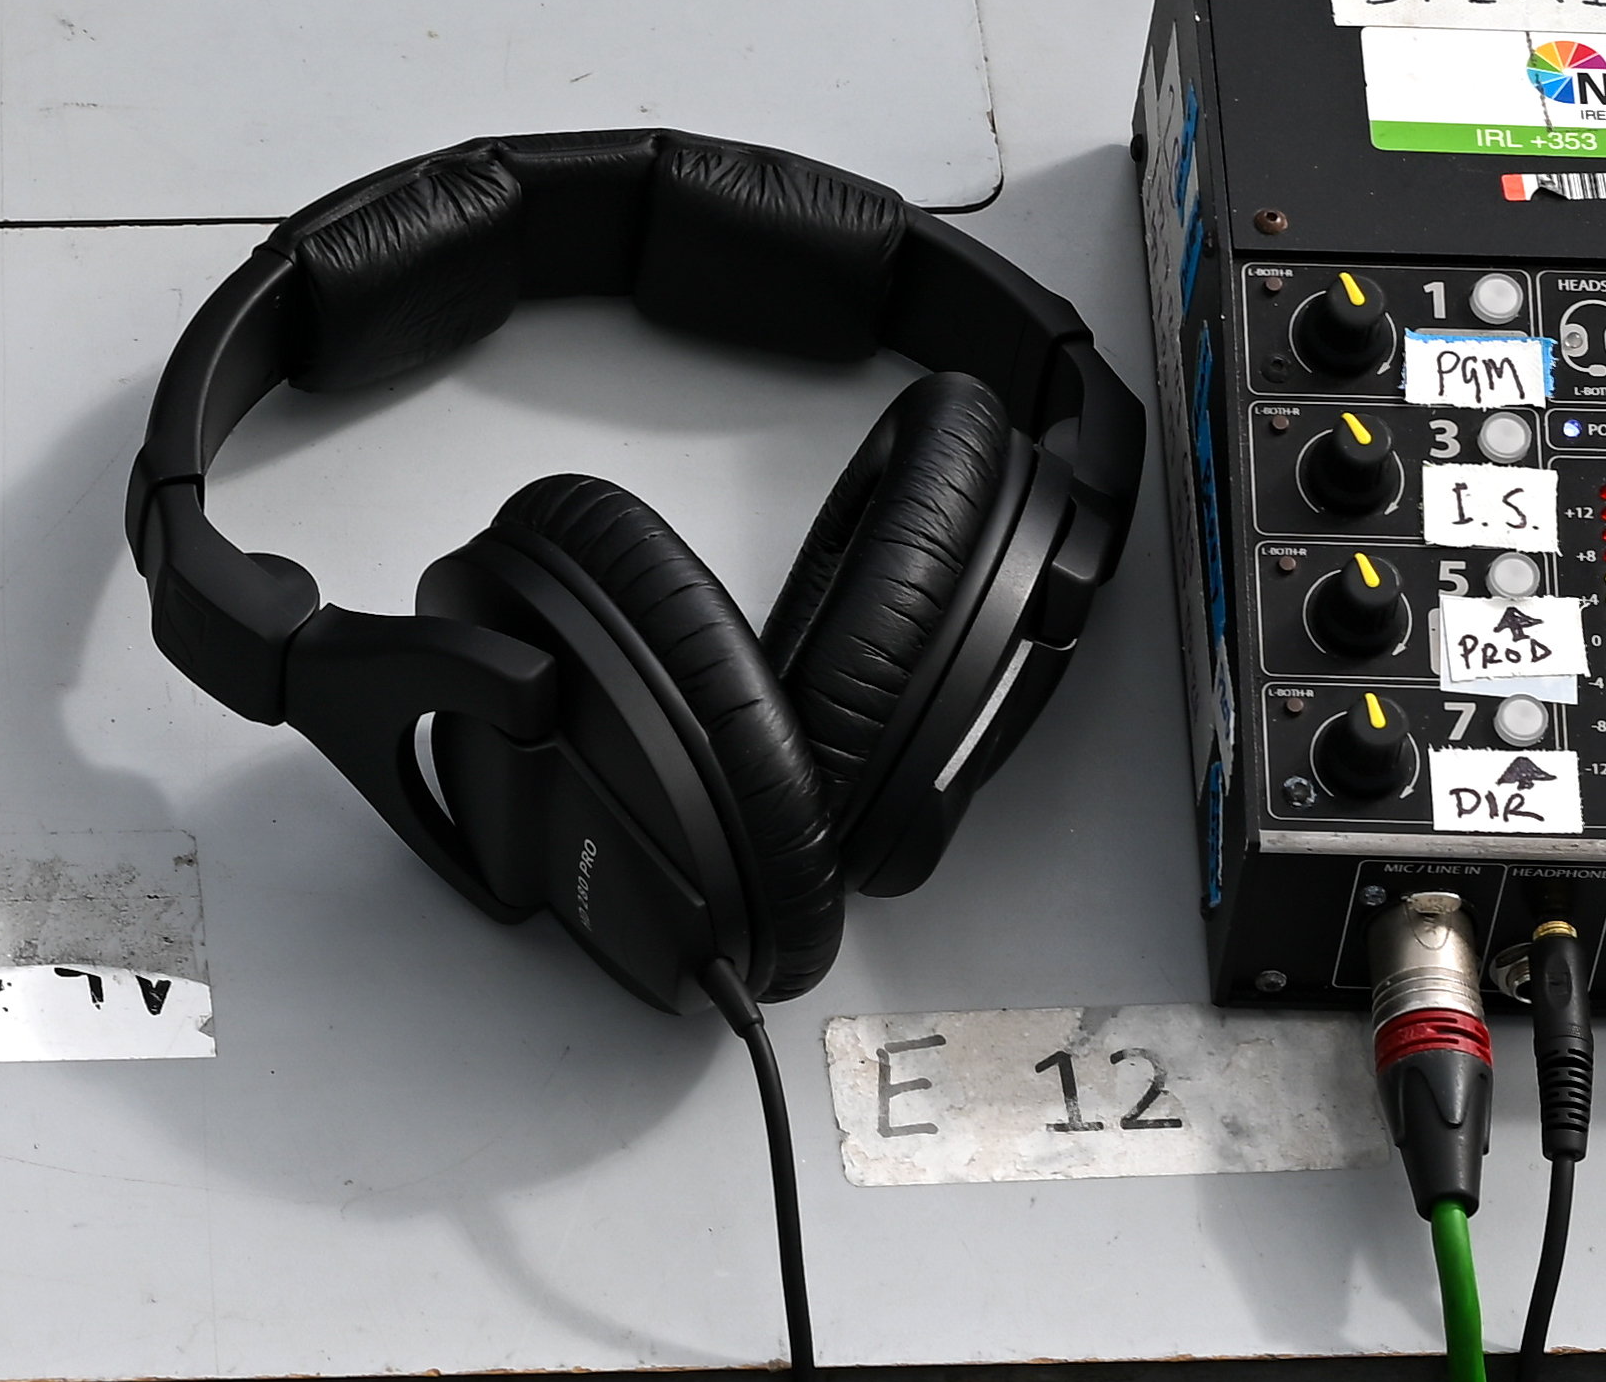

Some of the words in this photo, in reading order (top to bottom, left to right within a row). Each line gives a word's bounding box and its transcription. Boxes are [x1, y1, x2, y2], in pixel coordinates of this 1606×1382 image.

[1477, 129, 1523, 147] IRL
[1530, 132, 1597, 150] +353
[1248, 268, 1293, 276] L-BOTH-R
[1423, 282, 1446, 318] 1
[1255, 407, 1300, 418] L-BOTH-R
[1429, 420, 1460, 458] 3
[1452, 483, 1539, 530] I.S.
[1565, 507, 1593, 518] +12
[1576, 550, 1596, 562] +8
[1438, 561, 1469, 599] 5
[1458, 634, 1552, 669] PROD
[1592, 635, 1601, 646] 0
[1269, 689, 1314, 697] L-BOTH-R
[1444, 702, 1476, 740] 7
[1592, 720, 1606, 732] -8
[1449, 788, 1544, 822] DIR
[577, 838, 598, 875] PRO
[1384, 863, 1414, 873] MIC
[1426, 865, 1461, 875] LINE
[1464, 866, 1481, 875] IN
[878, 1034, 946, 1139] E
[1034, 1047, 1184, 1134] 12
